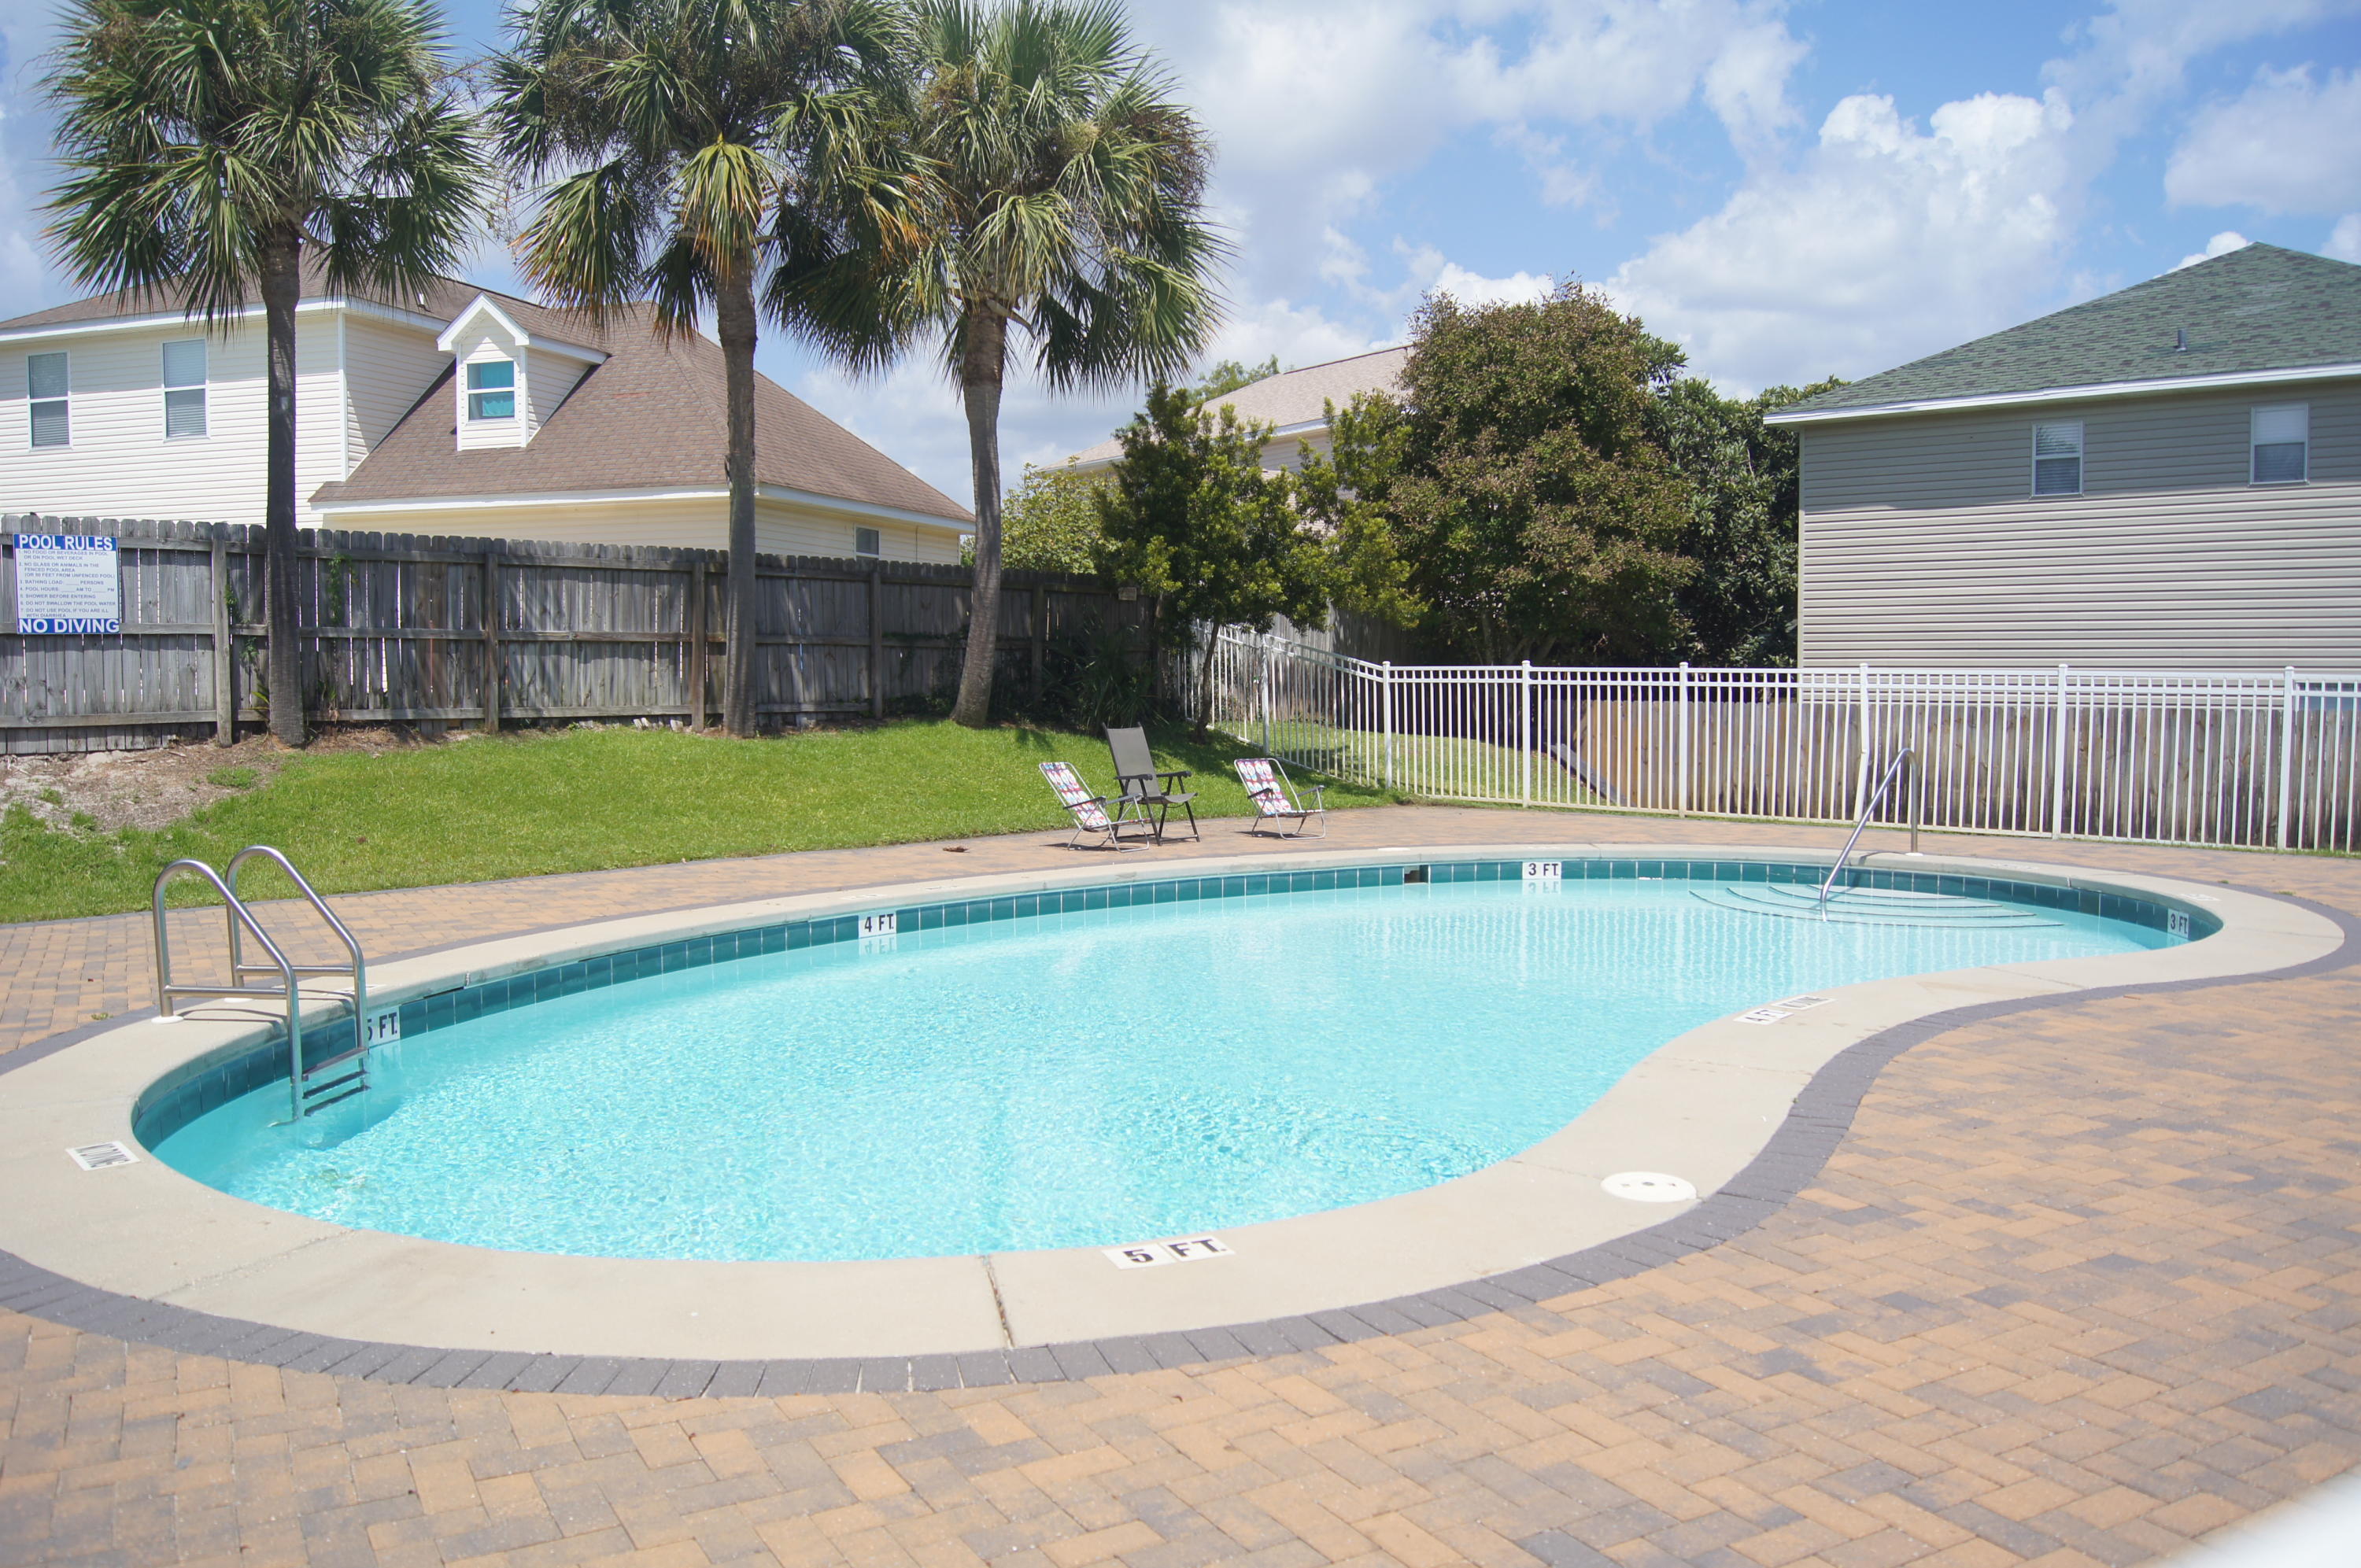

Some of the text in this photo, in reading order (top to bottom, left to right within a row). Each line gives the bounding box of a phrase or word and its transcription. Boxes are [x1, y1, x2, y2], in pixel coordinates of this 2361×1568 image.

[20, 535, 113, 551] POOL RULES
[19, 619, 119, 633] NO DIVING
[1528, 863, 1537, 876] 3
[865, 913, 894, 932] 4 FT.
[2171, 913, 2176, 930] 3
[379, 1012, 397, 1039] FT.
[1123, 1239, 1227, 1263] 5 FT.
